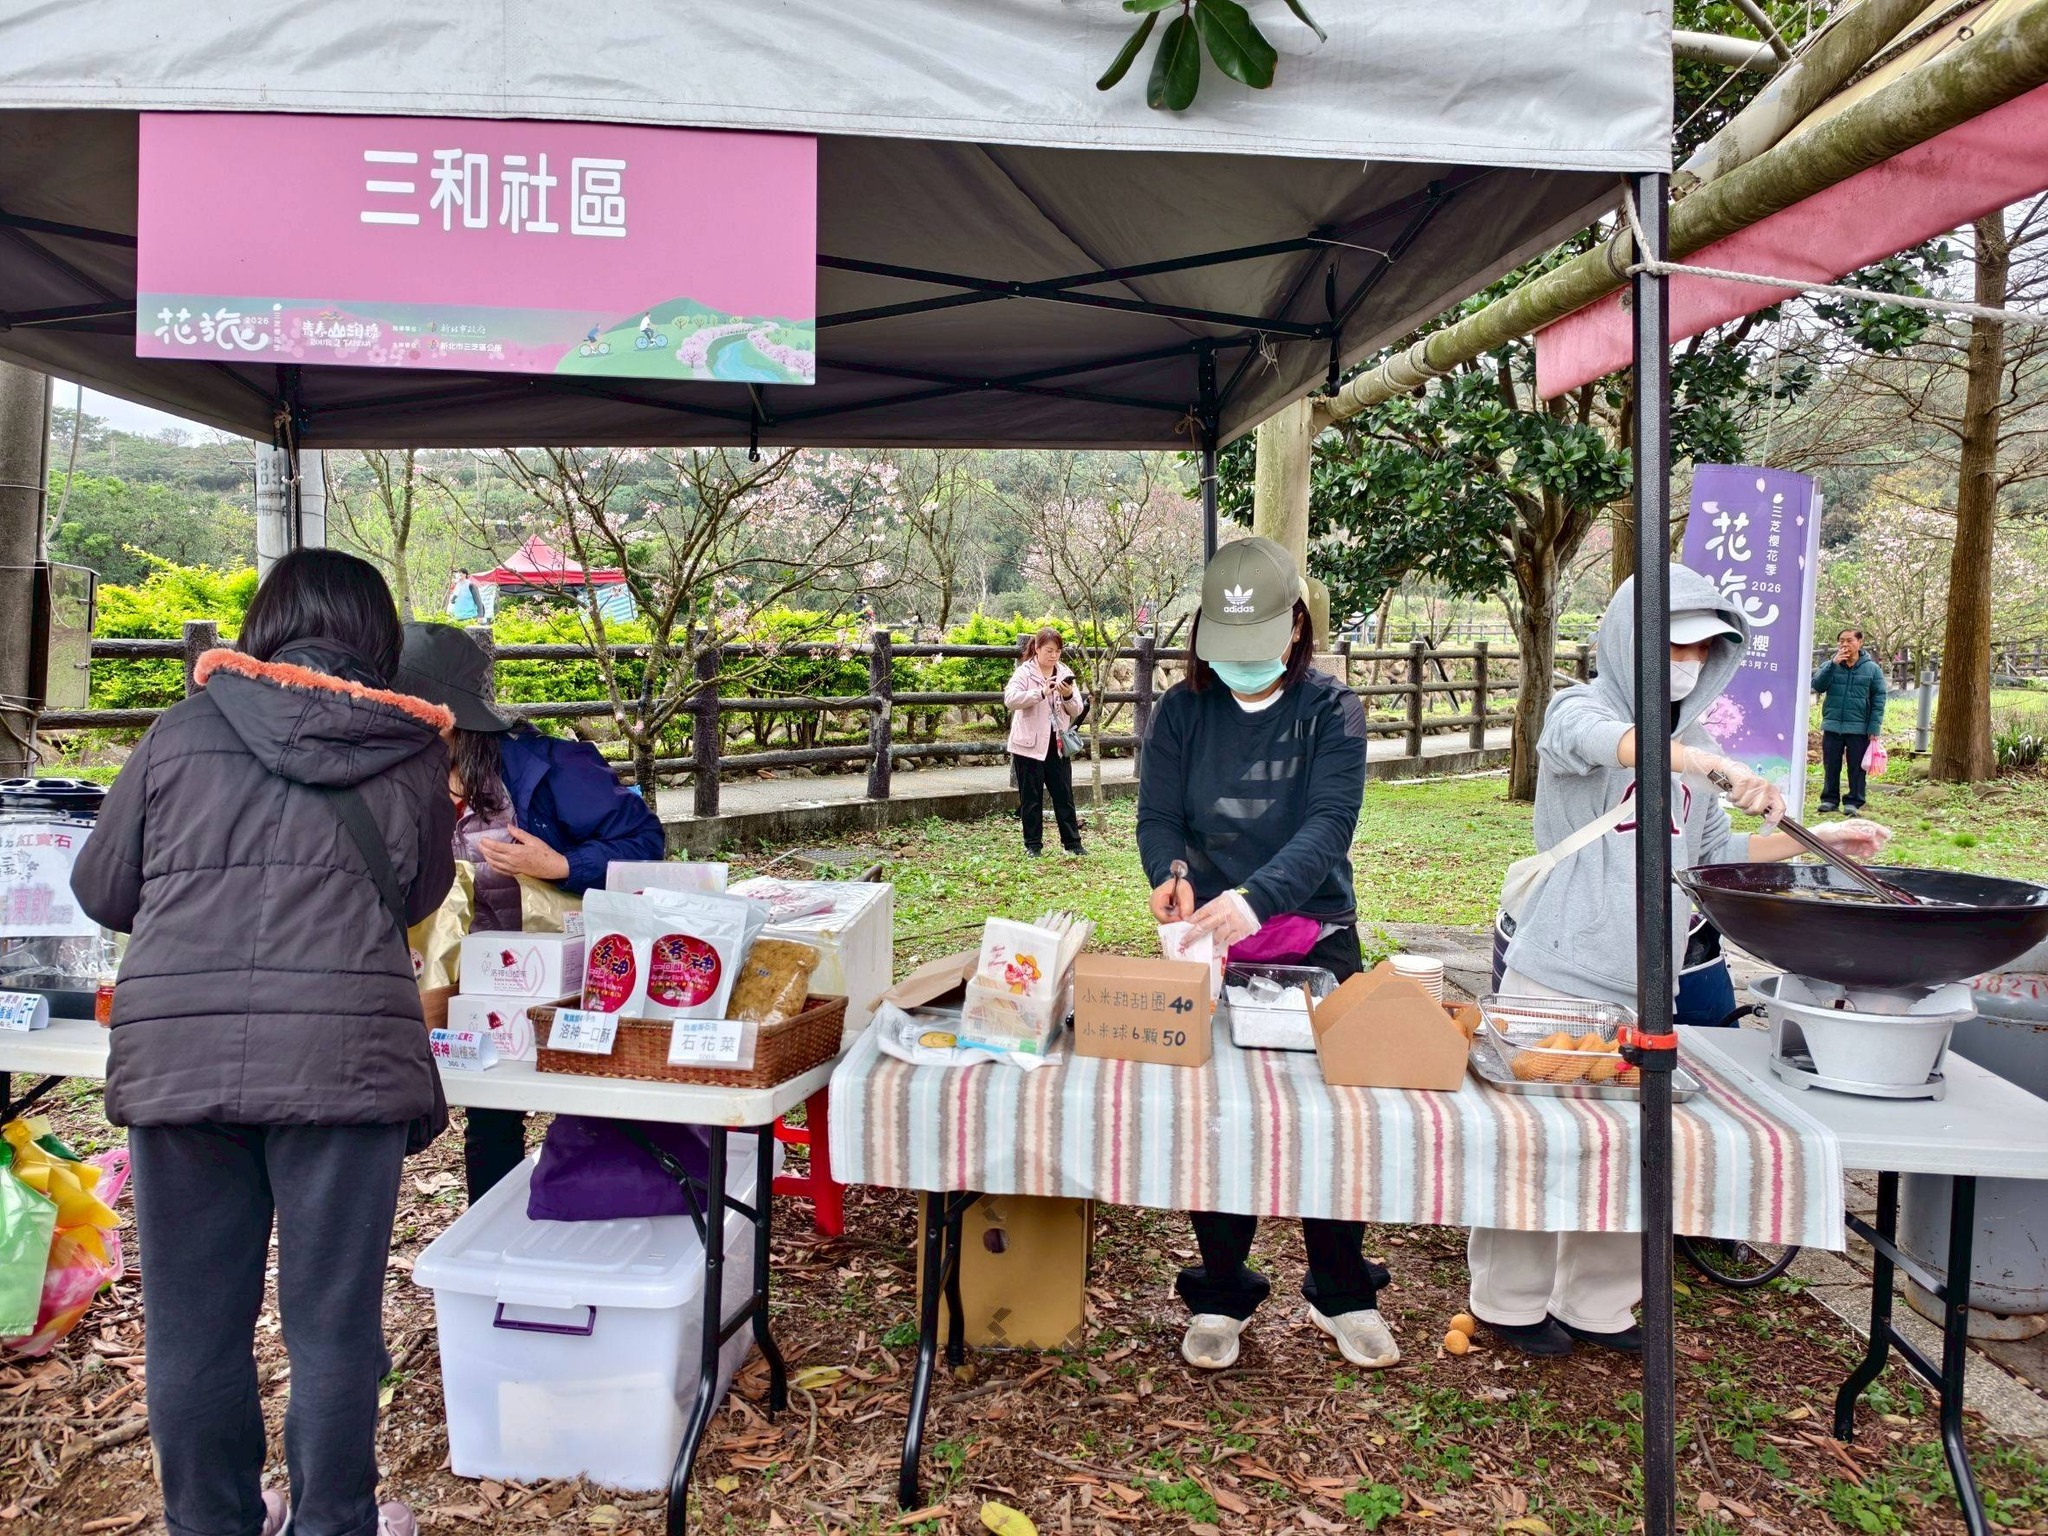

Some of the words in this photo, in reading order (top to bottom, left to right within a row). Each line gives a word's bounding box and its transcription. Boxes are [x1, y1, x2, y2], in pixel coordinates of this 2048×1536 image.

[360, 148, 627, 238] 三和社區
[243, 316, 269, 325] 2026
[1764, 504, 1783, 576] 三芝櫻花季
[1751, 581, 1782, 594] 2026
[1223, 604, 1255, 613] adidas
[1747, 634, 1769, 652] 櫻
[658, 939, 715, 975] 洛神
[1082, 987, 1166, 1012] 小米甜甜圈
[1168, 996, 1194, 1014] 40
[558, 1022, 612, 1044] 洛神一口酥
[1162, 1030, 1186, 1046] 50
[681, 1034, 736, 1052] 石花菜
